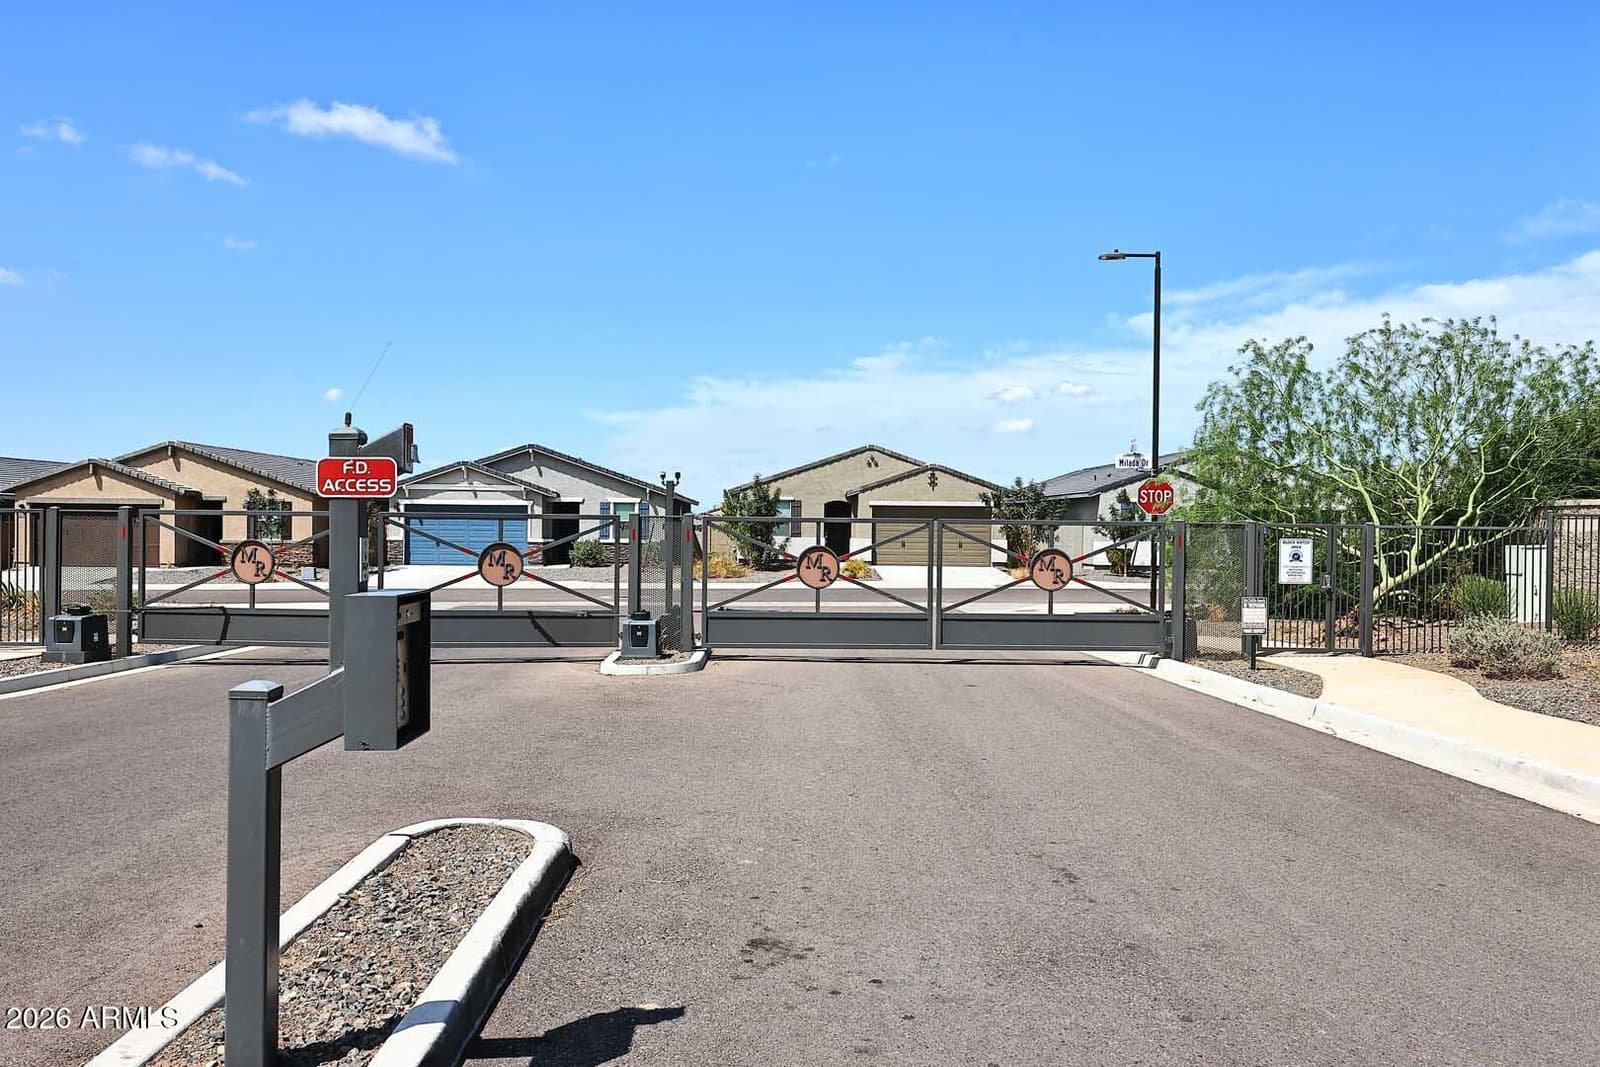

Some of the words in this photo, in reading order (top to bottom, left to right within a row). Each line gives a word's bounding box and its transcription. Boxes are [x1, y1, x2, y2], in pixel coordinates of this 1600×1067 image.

[343, 460, 371, 474] F.D.
[322, 479, 392, 492] ACCESS
[1140, 489, 1172, 503] STOP
